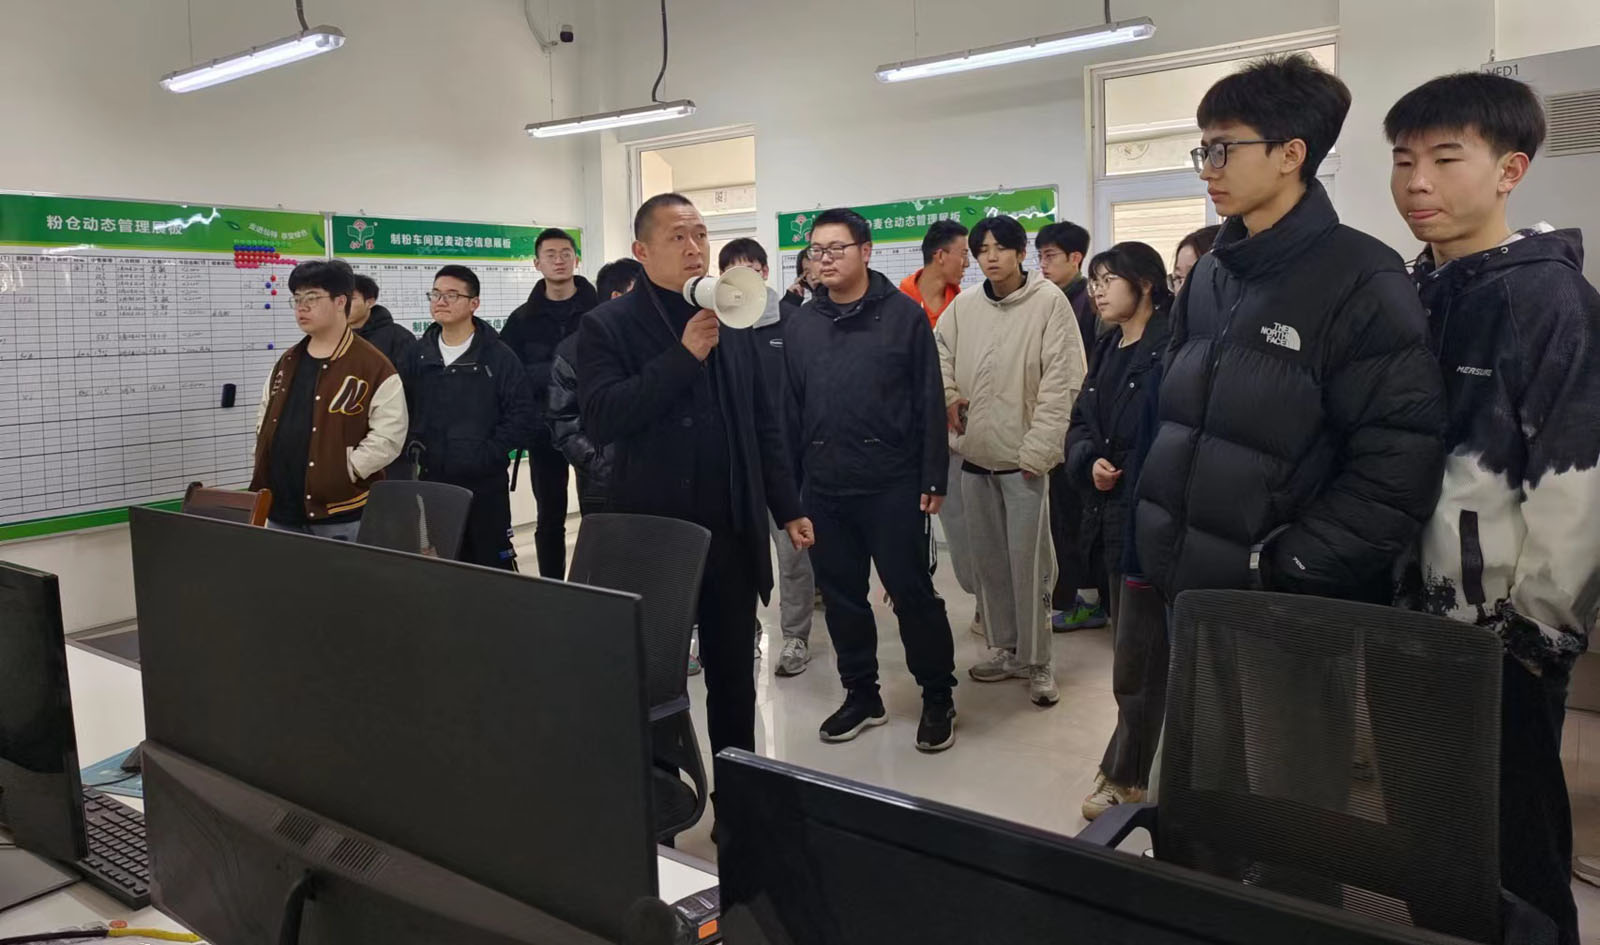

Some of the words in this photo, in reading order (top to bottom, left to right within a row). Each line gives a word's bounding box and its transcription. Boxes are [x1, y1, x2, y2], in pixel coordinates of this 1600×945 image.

[46, 215, 183, 235] 粉仓动态管理展板
[390, 233, 511, 249] 制粉车间配麦动态信息展板
[1260, 326, 1288, 340] NORTH
[1274, 322, 1289, 333] THE
[1266, 334, 1287, 347] FACE
